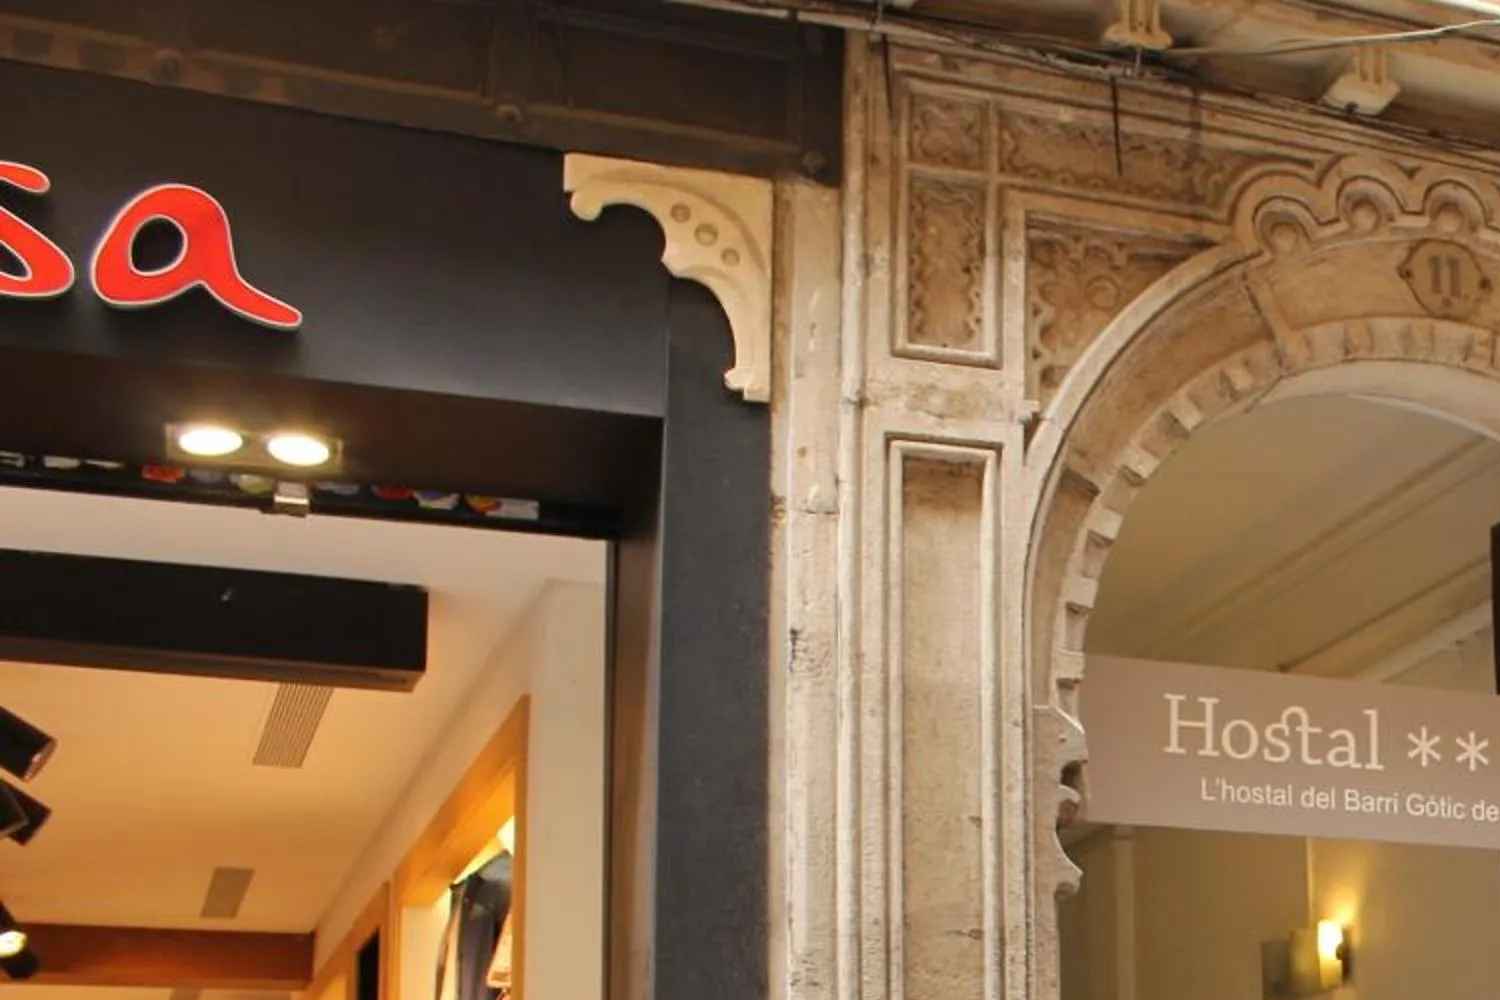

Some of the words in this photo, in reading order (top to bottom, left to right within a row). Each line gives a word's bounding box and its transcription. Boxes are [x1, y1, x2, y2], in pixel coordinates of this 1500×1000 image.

[1163, 693, 1385, 771] Hostal
[1201, 777, 1294, 808] L'hostal
[1300, 783, 1337, 811] del
[1344, 788, 1400, 816] Barri
[1472, 800, 1500, 823] de
